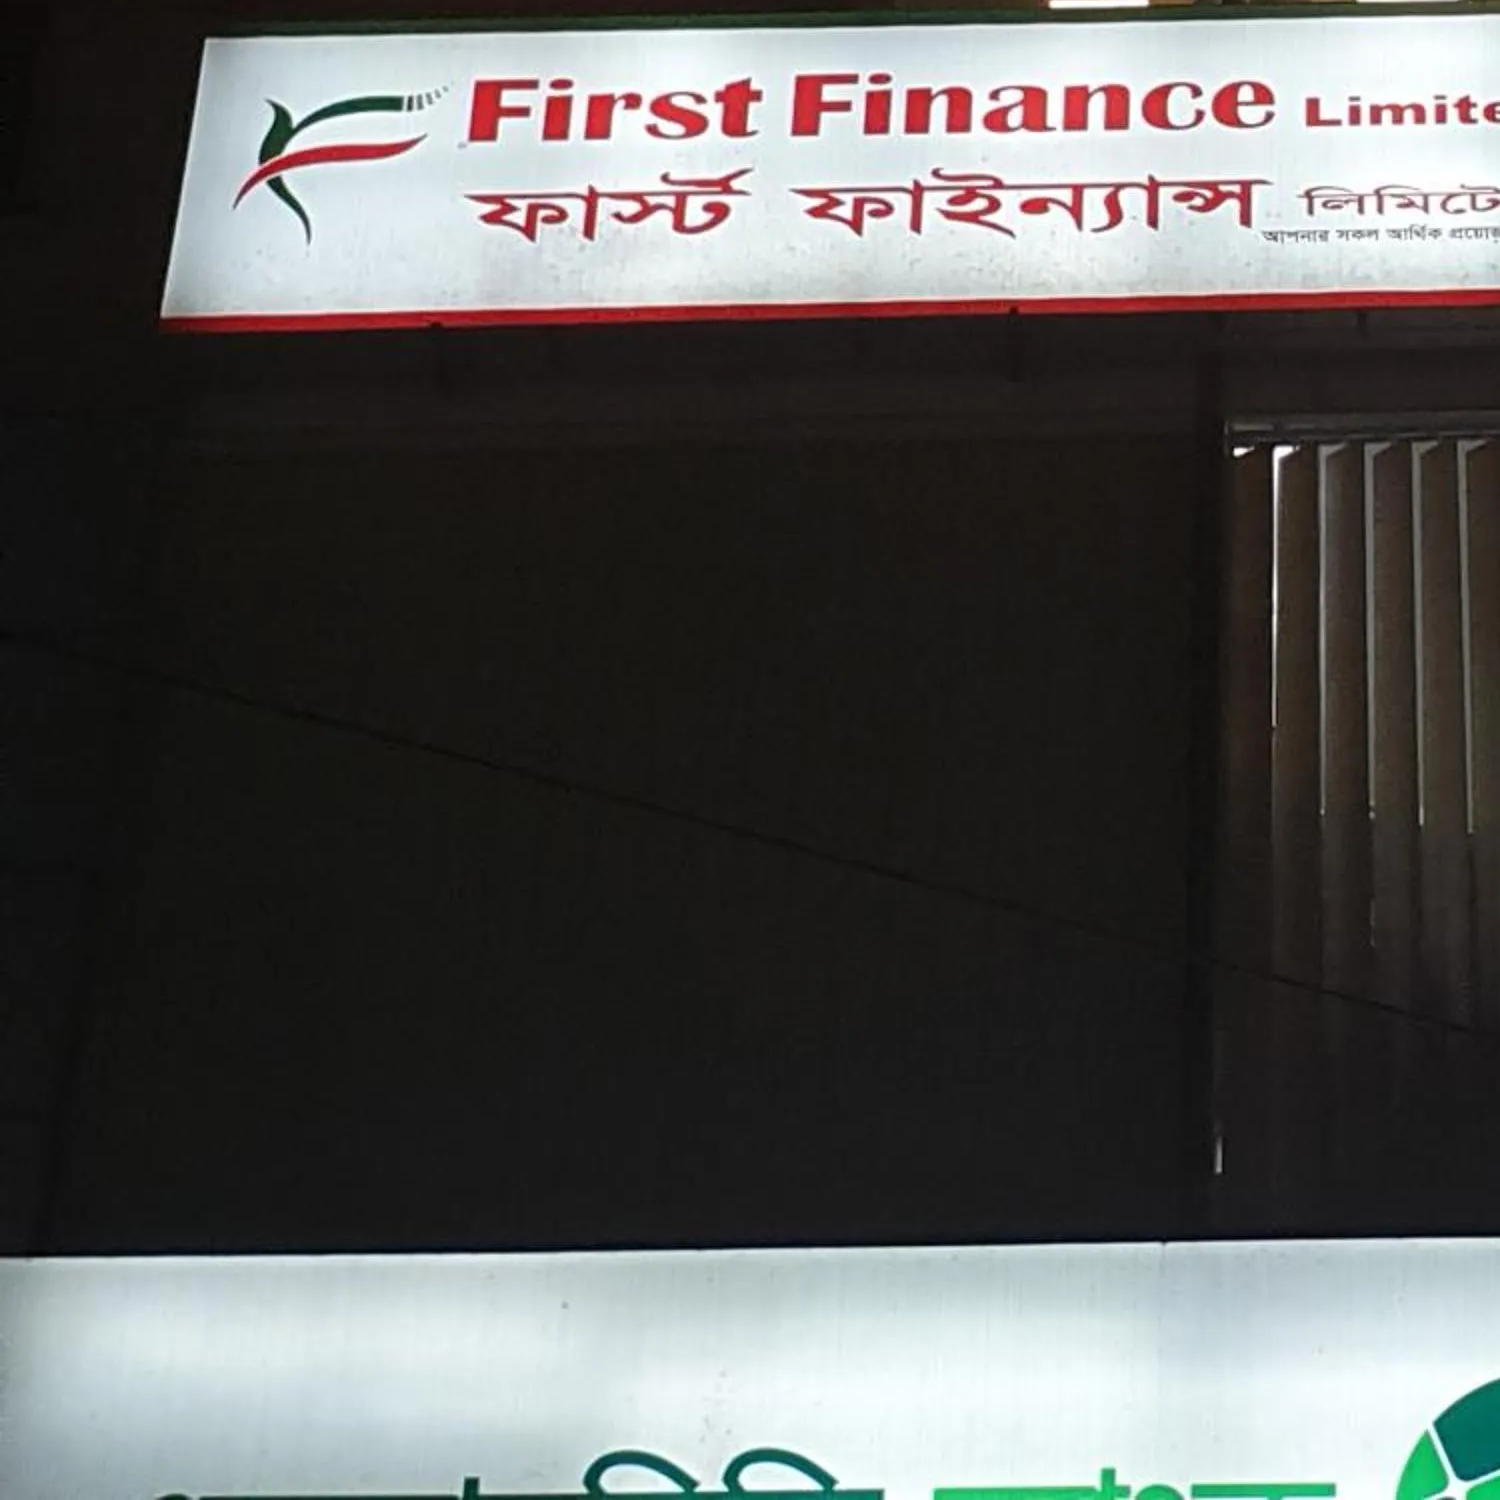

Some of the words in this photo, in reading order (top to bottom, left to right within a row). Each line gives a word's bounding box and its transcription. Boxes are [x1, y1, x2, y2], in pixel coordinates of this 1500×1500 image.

[468, 76, 764, 143] First
[790, 72, 1277, 137] Finance
[463, 167, 755, 242] ফার্স্ট
[787, 165, 1274, 239] ফাইন্যান্স
